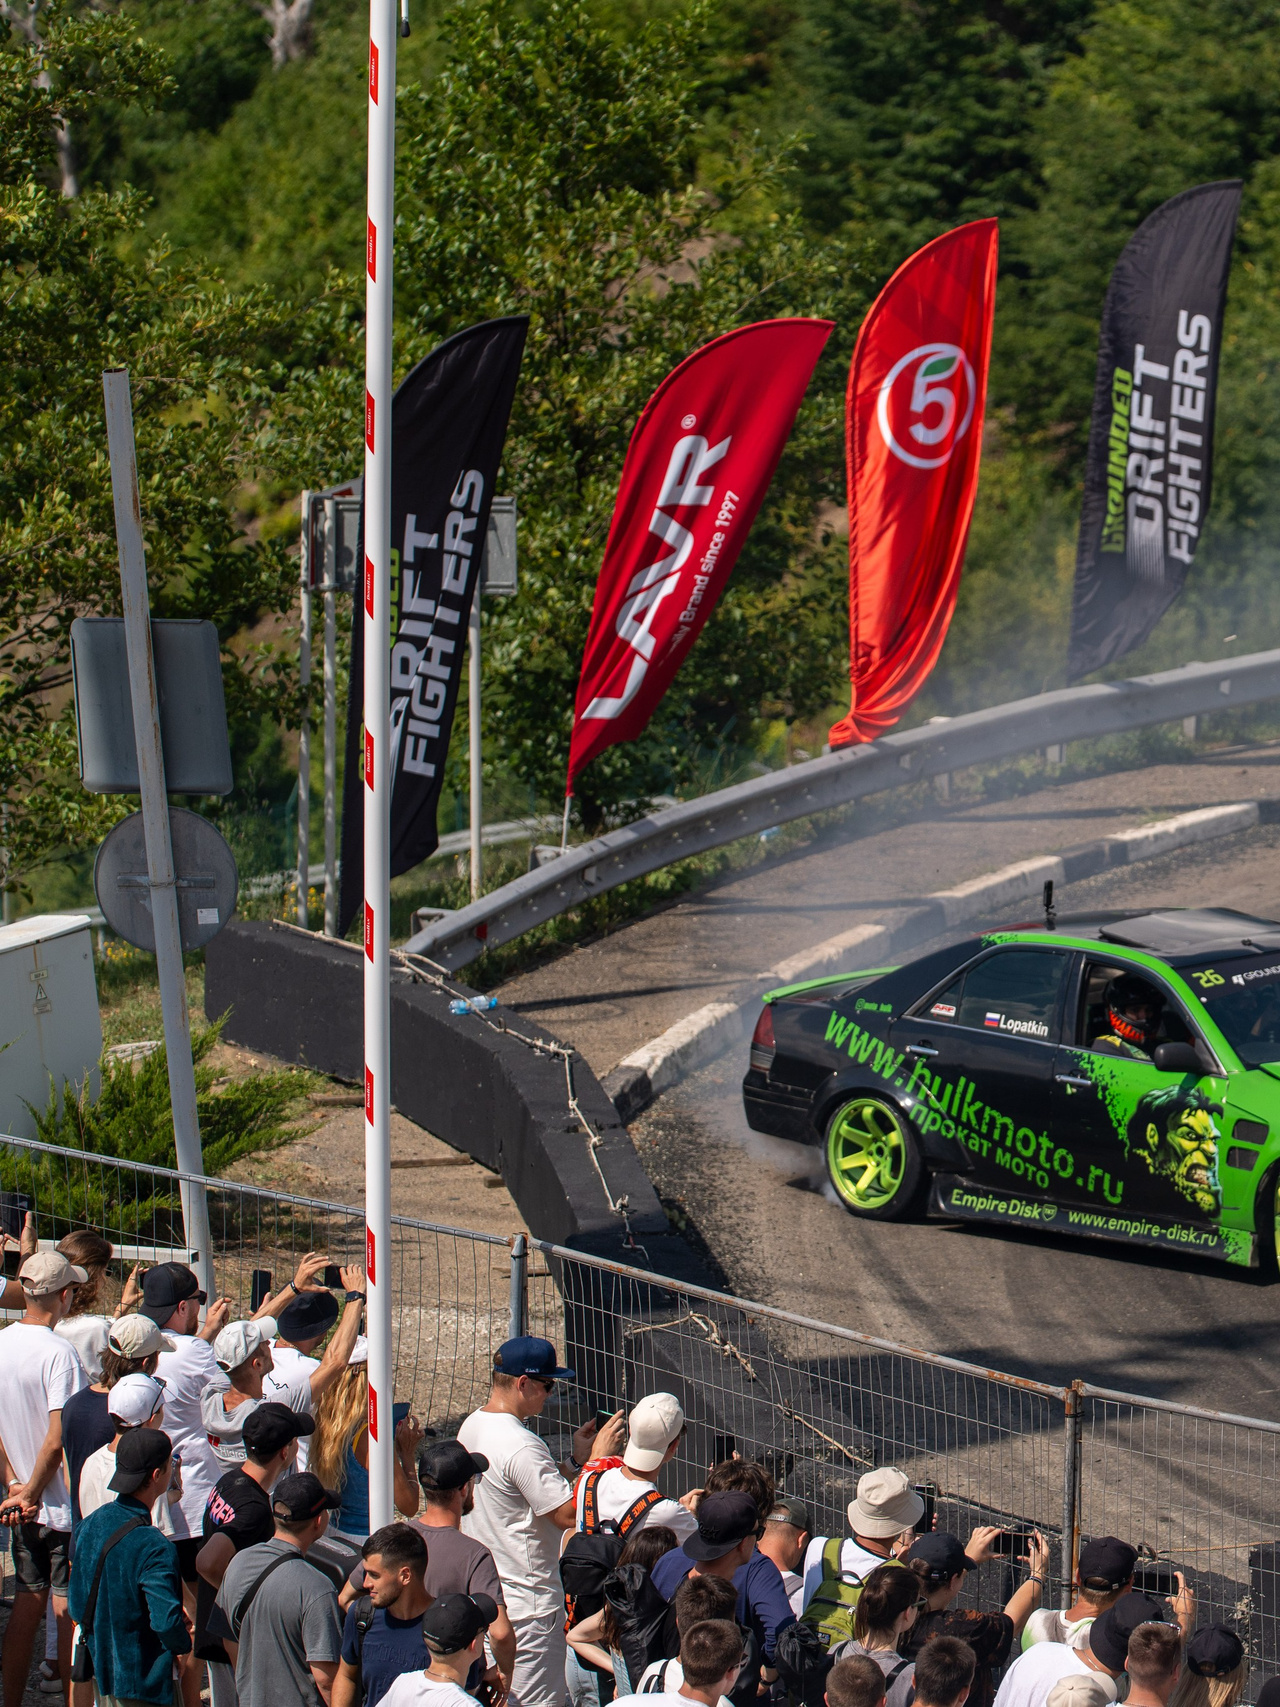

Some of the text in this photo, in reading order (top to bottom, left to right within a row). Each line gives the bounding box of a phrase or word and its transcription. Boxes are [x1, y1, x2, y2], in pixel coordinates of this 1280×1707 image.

[1126, 343, 1170, 540] DRIFT
[1167, 308, 1212, 565] FIGHTERS
[581, 434, 732, 720] LAVR
[679, 574, 710, 623] Brand
[700, 531, 726, 574] since
[715, 489, 740, 528] 1997
[403, 469, 485, 778] FIGHTERS
[1192, 968, 1226, 989] 26
[1000, 1014, 1049, 1037] Lopatkin
[822, 1009, 1124, 1205] www.hulkmoto.ru
[1068, 1210, 1218, 1247] www.empire-disk.ru
[218, 1445, 248, 1460] Hidro
[620, 1514, 633, 1534] NIKE
[631, 1498, 647, 1517] NIKE
